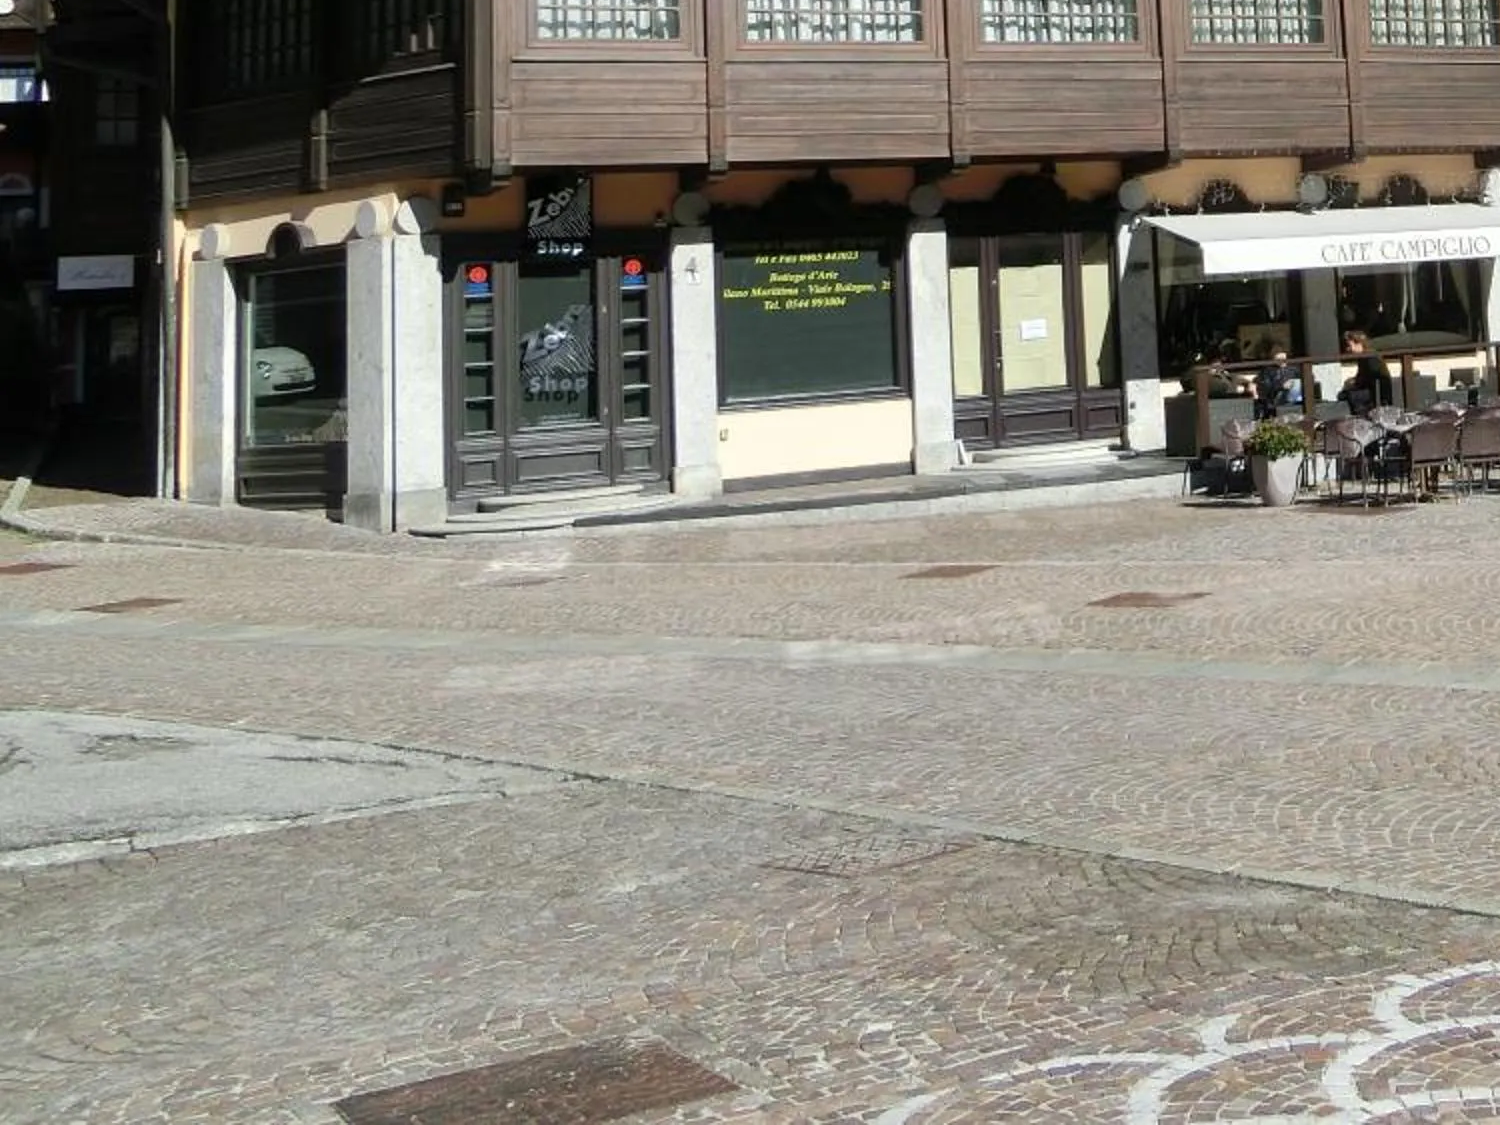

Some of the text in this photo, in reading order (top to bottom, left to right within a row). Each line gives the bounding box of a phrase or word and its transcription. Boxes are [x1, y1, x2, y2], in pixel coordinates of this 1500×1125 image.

[537, 240, 584, 256] Shop
[1379, 234, 1491, 261] CAMPIGLIO
[529, 374, 588, 392] Shop
